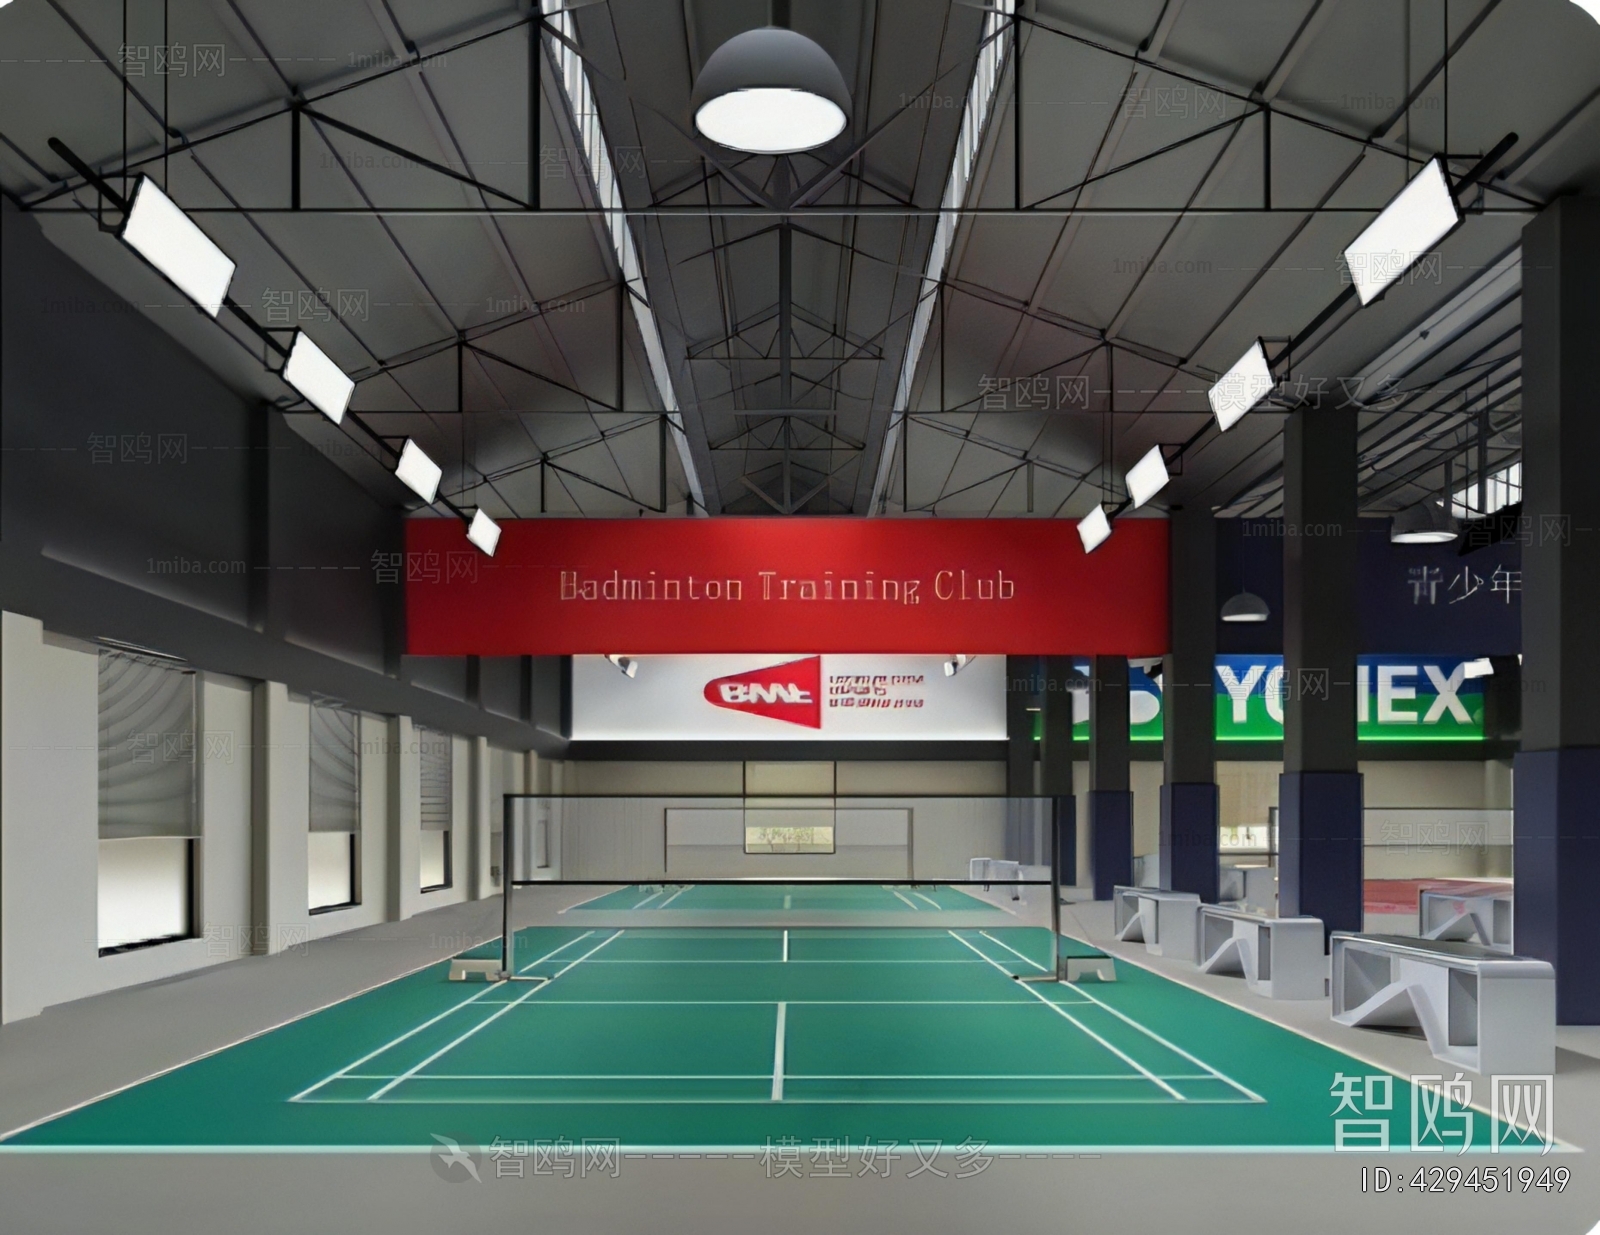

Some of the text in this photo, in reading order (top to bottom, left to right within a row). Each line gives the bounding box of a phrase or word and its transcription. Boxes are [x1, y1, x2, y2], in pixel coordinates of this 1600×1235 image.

[560, 569, 1015, 604] Badminton Training Club
